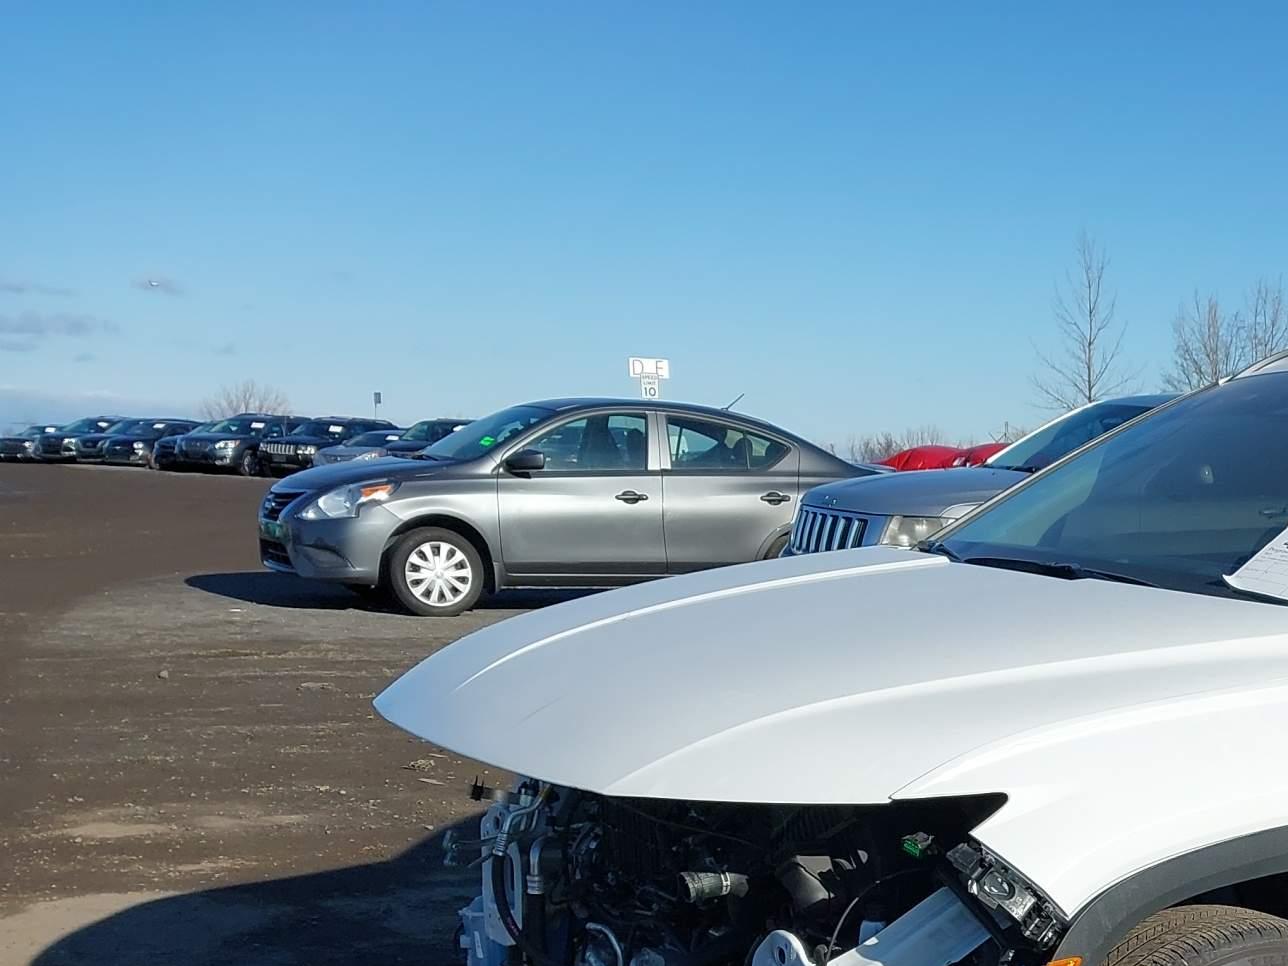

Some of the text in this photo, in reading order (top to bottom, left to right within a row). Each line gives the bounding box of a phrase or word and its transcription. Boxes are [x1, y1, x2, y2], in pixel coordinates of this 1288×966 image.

[632, 359, 665, 377] D E
[644, 387, 657, 397] 10
